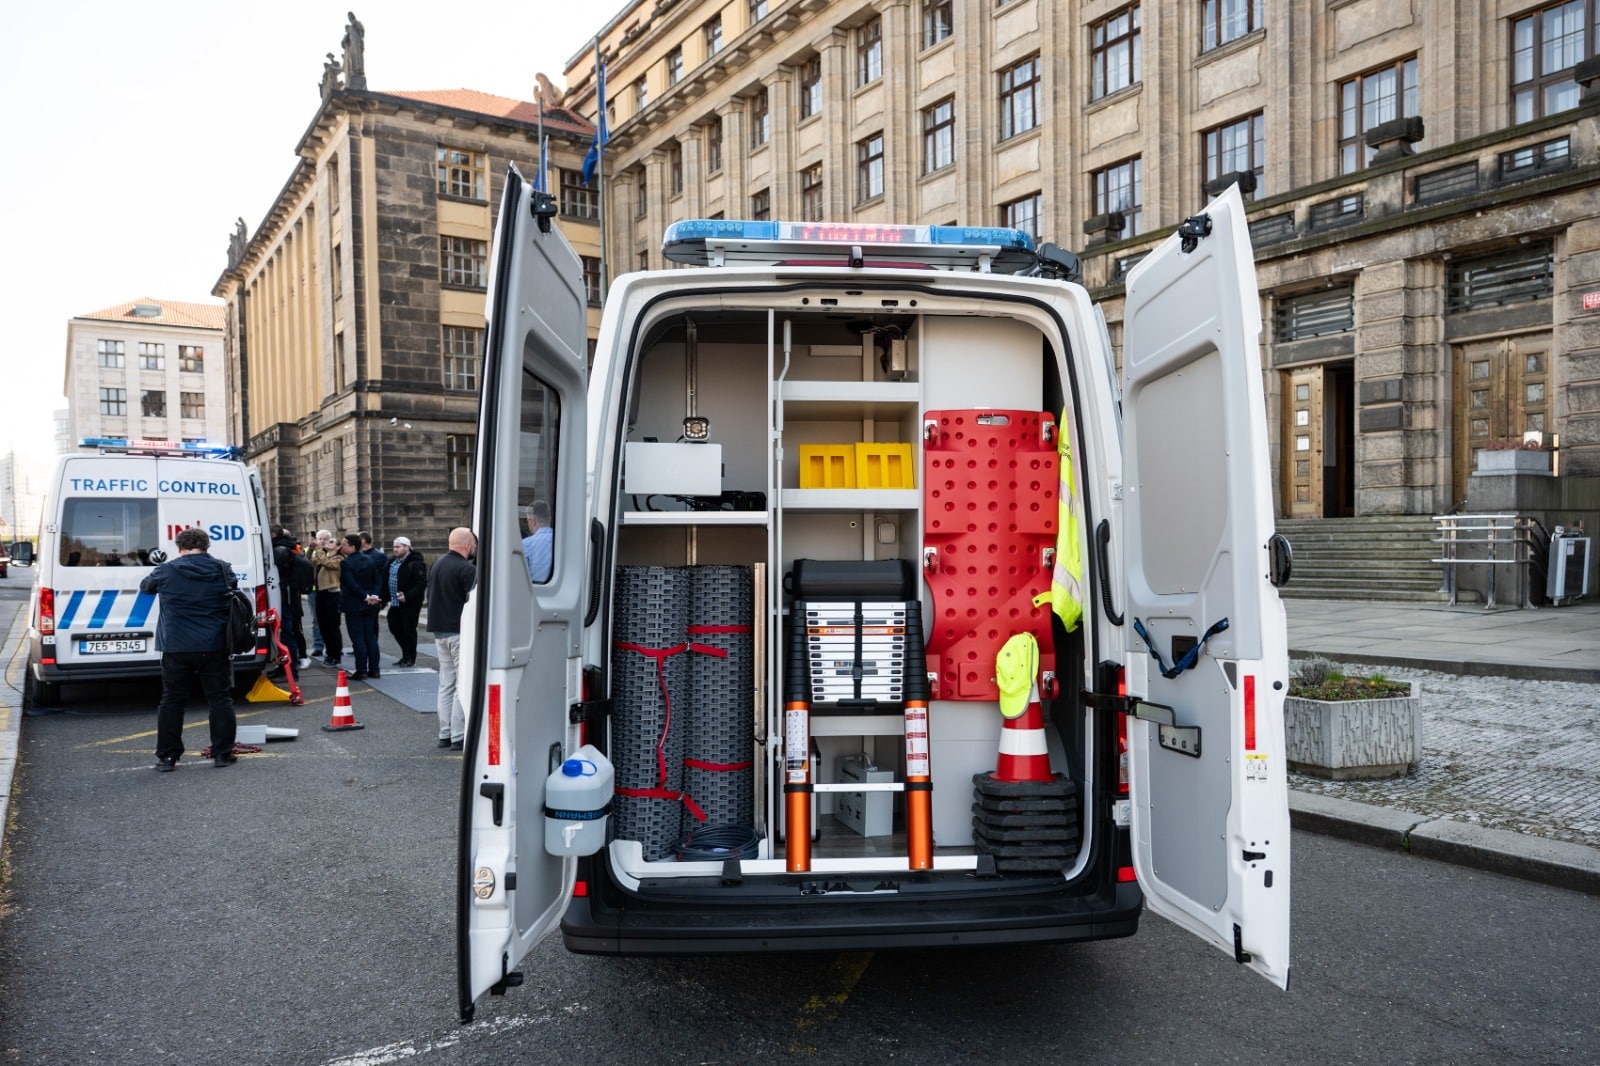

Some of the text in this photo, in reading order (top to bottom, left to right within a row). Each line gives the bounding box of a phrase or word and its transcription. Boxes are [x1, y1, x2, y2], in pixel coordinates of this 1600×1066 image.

[70, 479, 241, 496] TRAFFIC CONTROL
[115, 640, 141, 651] 5345
